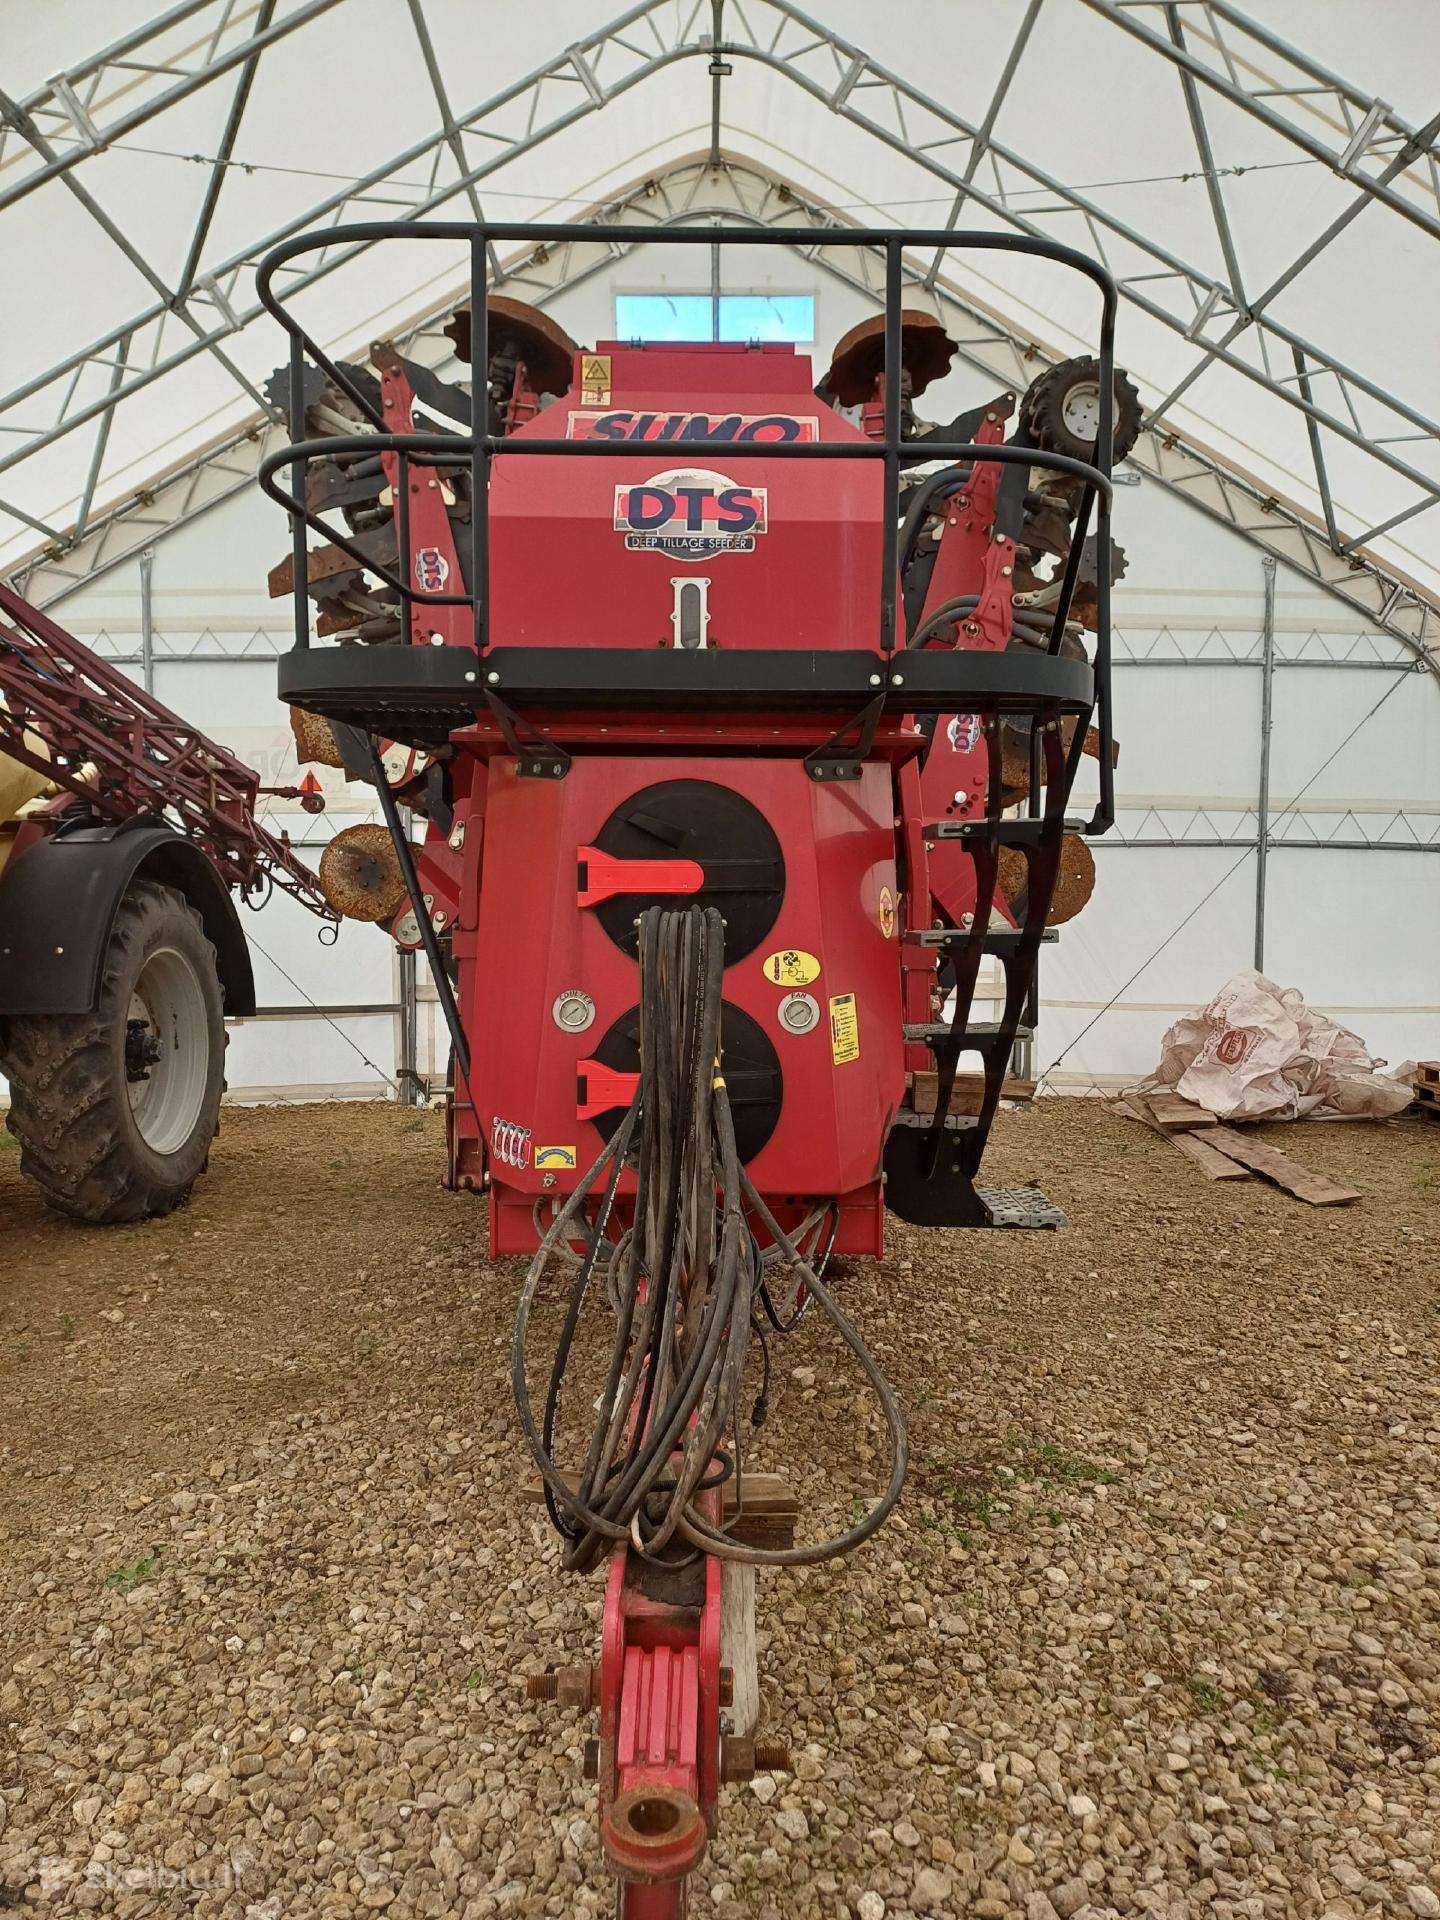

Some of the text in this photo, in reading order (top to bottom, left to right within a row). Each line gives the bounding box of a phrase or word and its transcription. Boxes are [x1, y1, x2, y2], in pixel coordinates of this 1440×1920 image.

[590, 413, 801, 442] SUMO
[628, 486, 758, 533] DTS
[631, 537, 747, 549] DEEP TILLAGE SEEDER
[423, 551, 443, 588] DTS
